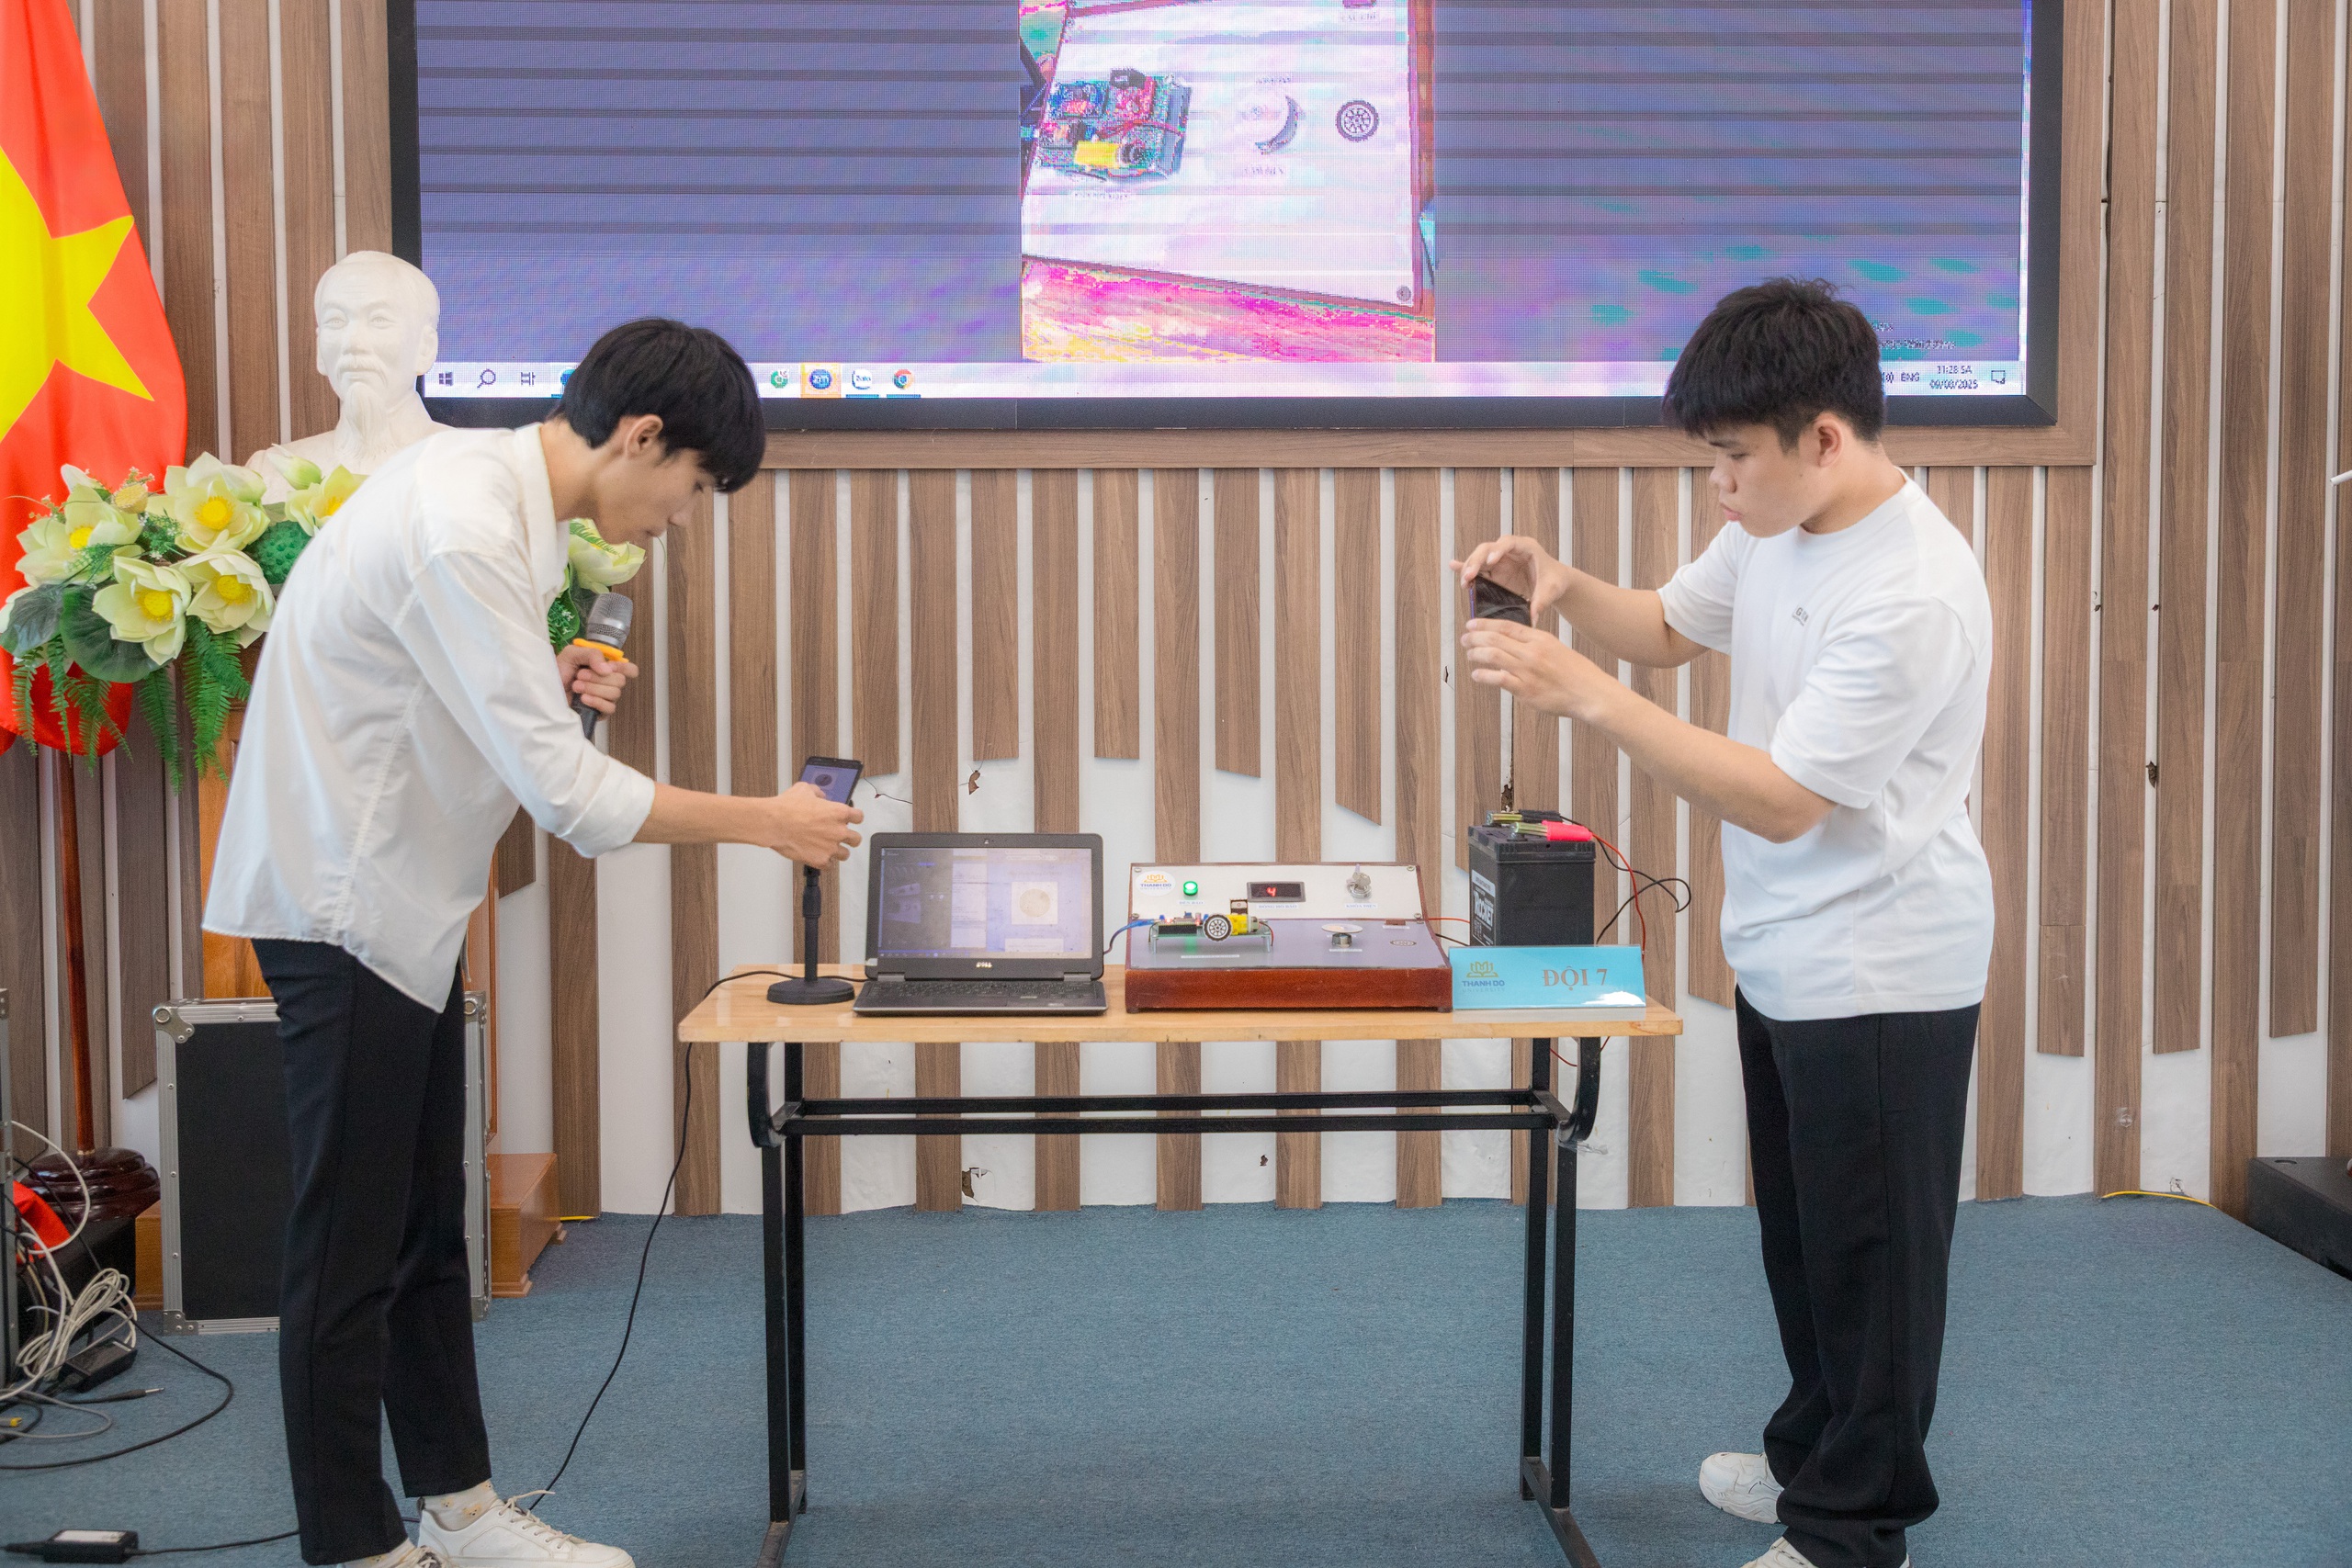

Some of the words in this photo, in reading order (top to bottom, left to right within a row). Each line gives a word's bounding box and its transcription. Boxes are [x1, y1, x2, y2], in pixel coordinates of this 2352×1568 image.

[1937, 366, 1959, 374] 11:28
[1961, 366, 1973, 374] SA
[1900, 372, 1920, 382] ENG
[1266, 886, 1277, 897] 4
[1543, 965, 1589, 991] ĐỘI
[1596, 968, 1608, 986] 7
